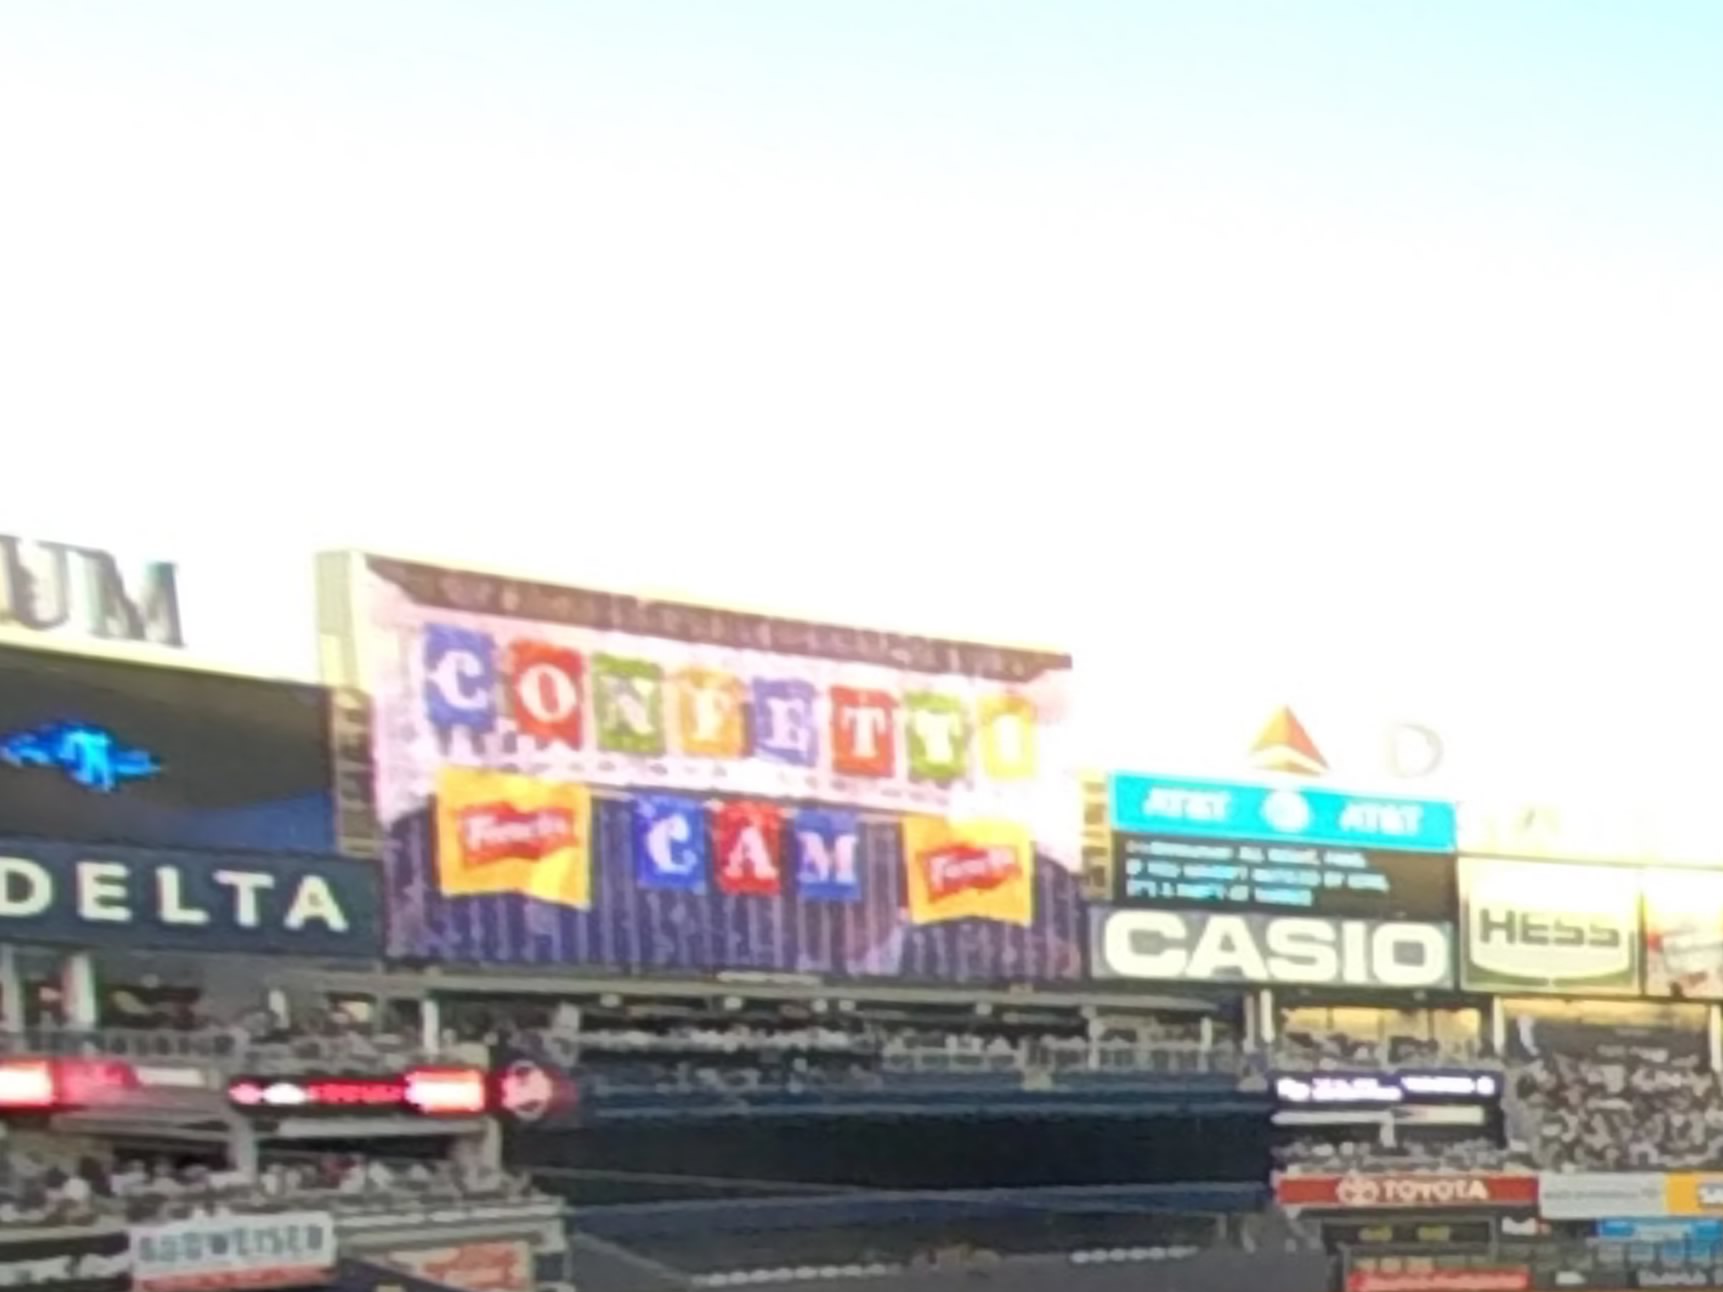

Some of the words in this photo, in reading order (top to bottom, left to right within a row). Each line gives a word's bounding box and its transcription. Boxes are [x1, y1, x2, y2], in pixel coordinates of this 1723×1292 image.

[428, 648, 1023, 762] CONFETTI
[647, 812, 858, 885] CAM
[0, 857, 350, 933] DELTA
[1479, 907, 1621, 947] HESS
[1104, 908, 1448, 987] CASIO
[1383, 1179, 1488, 1201] TOYOTA
